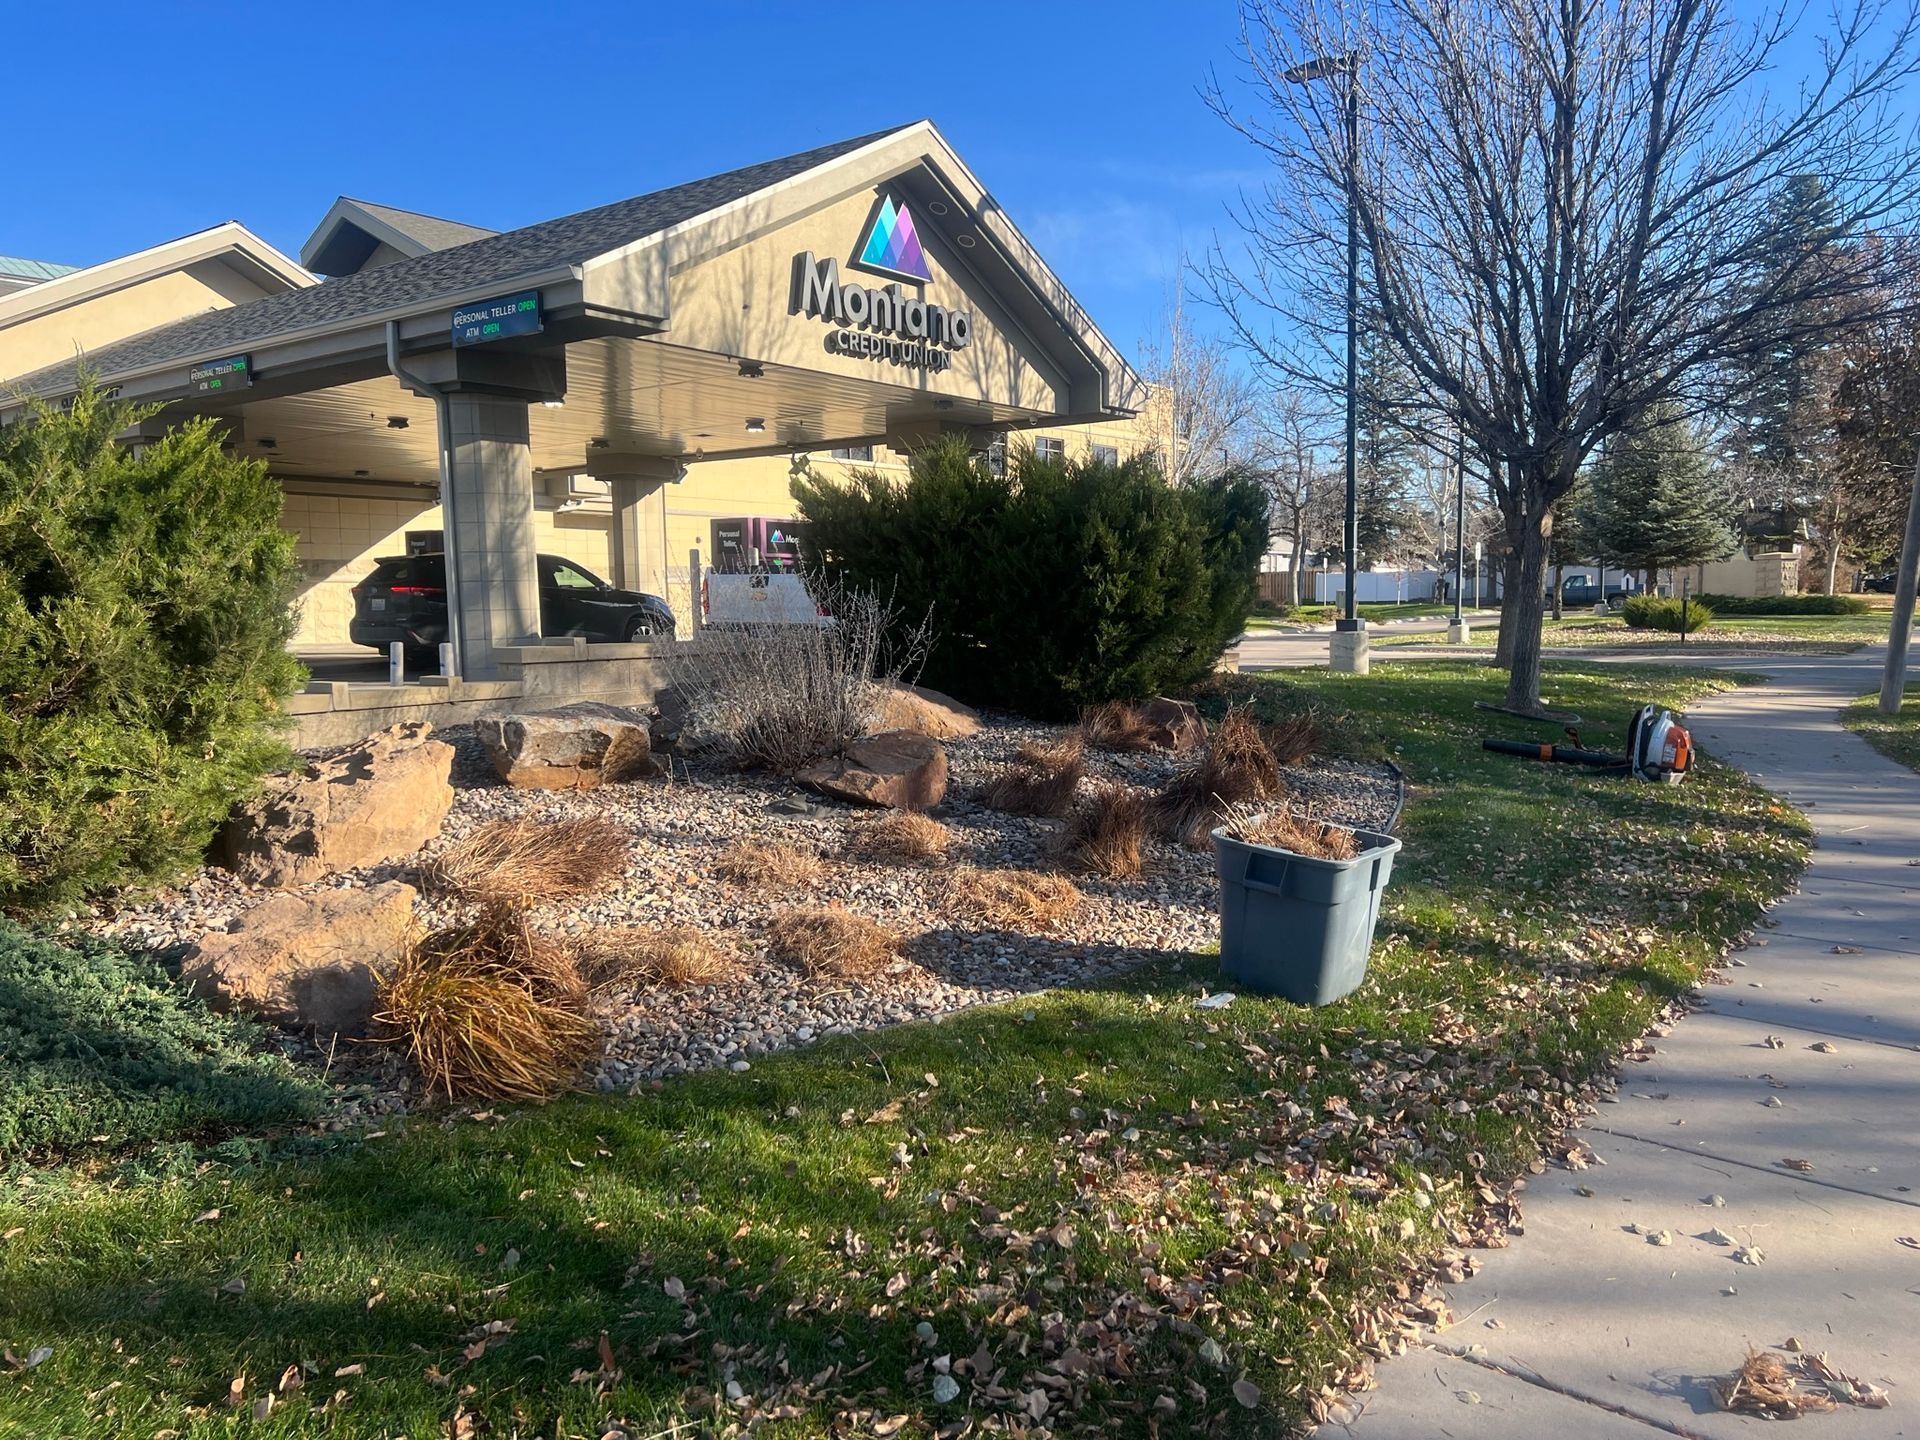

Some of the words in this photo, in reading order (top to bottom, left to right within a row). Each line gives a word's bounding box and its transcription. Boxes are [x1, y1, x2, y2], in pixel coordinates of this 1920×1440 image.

[455, 310, 489, 325] PERSONAL
[491, 304, 516, 318] TELLER
[518, 300, 536, 312] OPEN
[799, 251, 971, 347] Montana
[466, 327, 480, 338] ATM
[482, 323, 500, 335] OPEN
[836, 328, 896, 359] CREDIT
[901, 342, 951, 370] UNION
